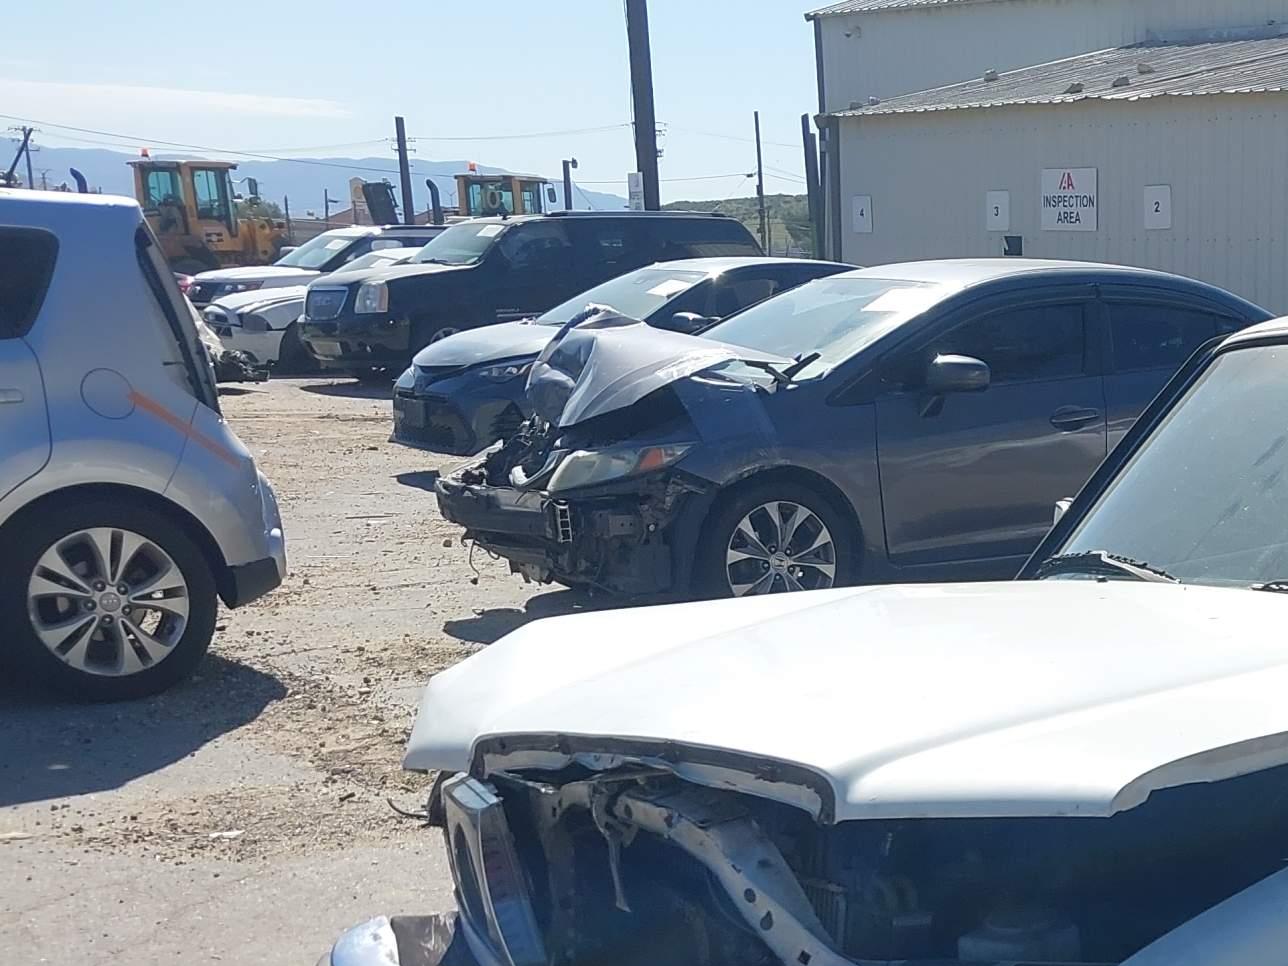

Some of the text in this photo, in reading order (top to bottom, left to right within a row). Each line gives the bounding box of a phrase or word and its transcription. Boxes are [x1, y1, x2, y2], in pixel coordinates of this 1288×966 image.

[1043, 195, 1095, 208] INSPECTION
[1154, 201, 1161, 213] 2
[859, 208, 865, 217] 4
[993, 206, 1000, 217] 3
[1056, 211, 1081, 224] AREA
